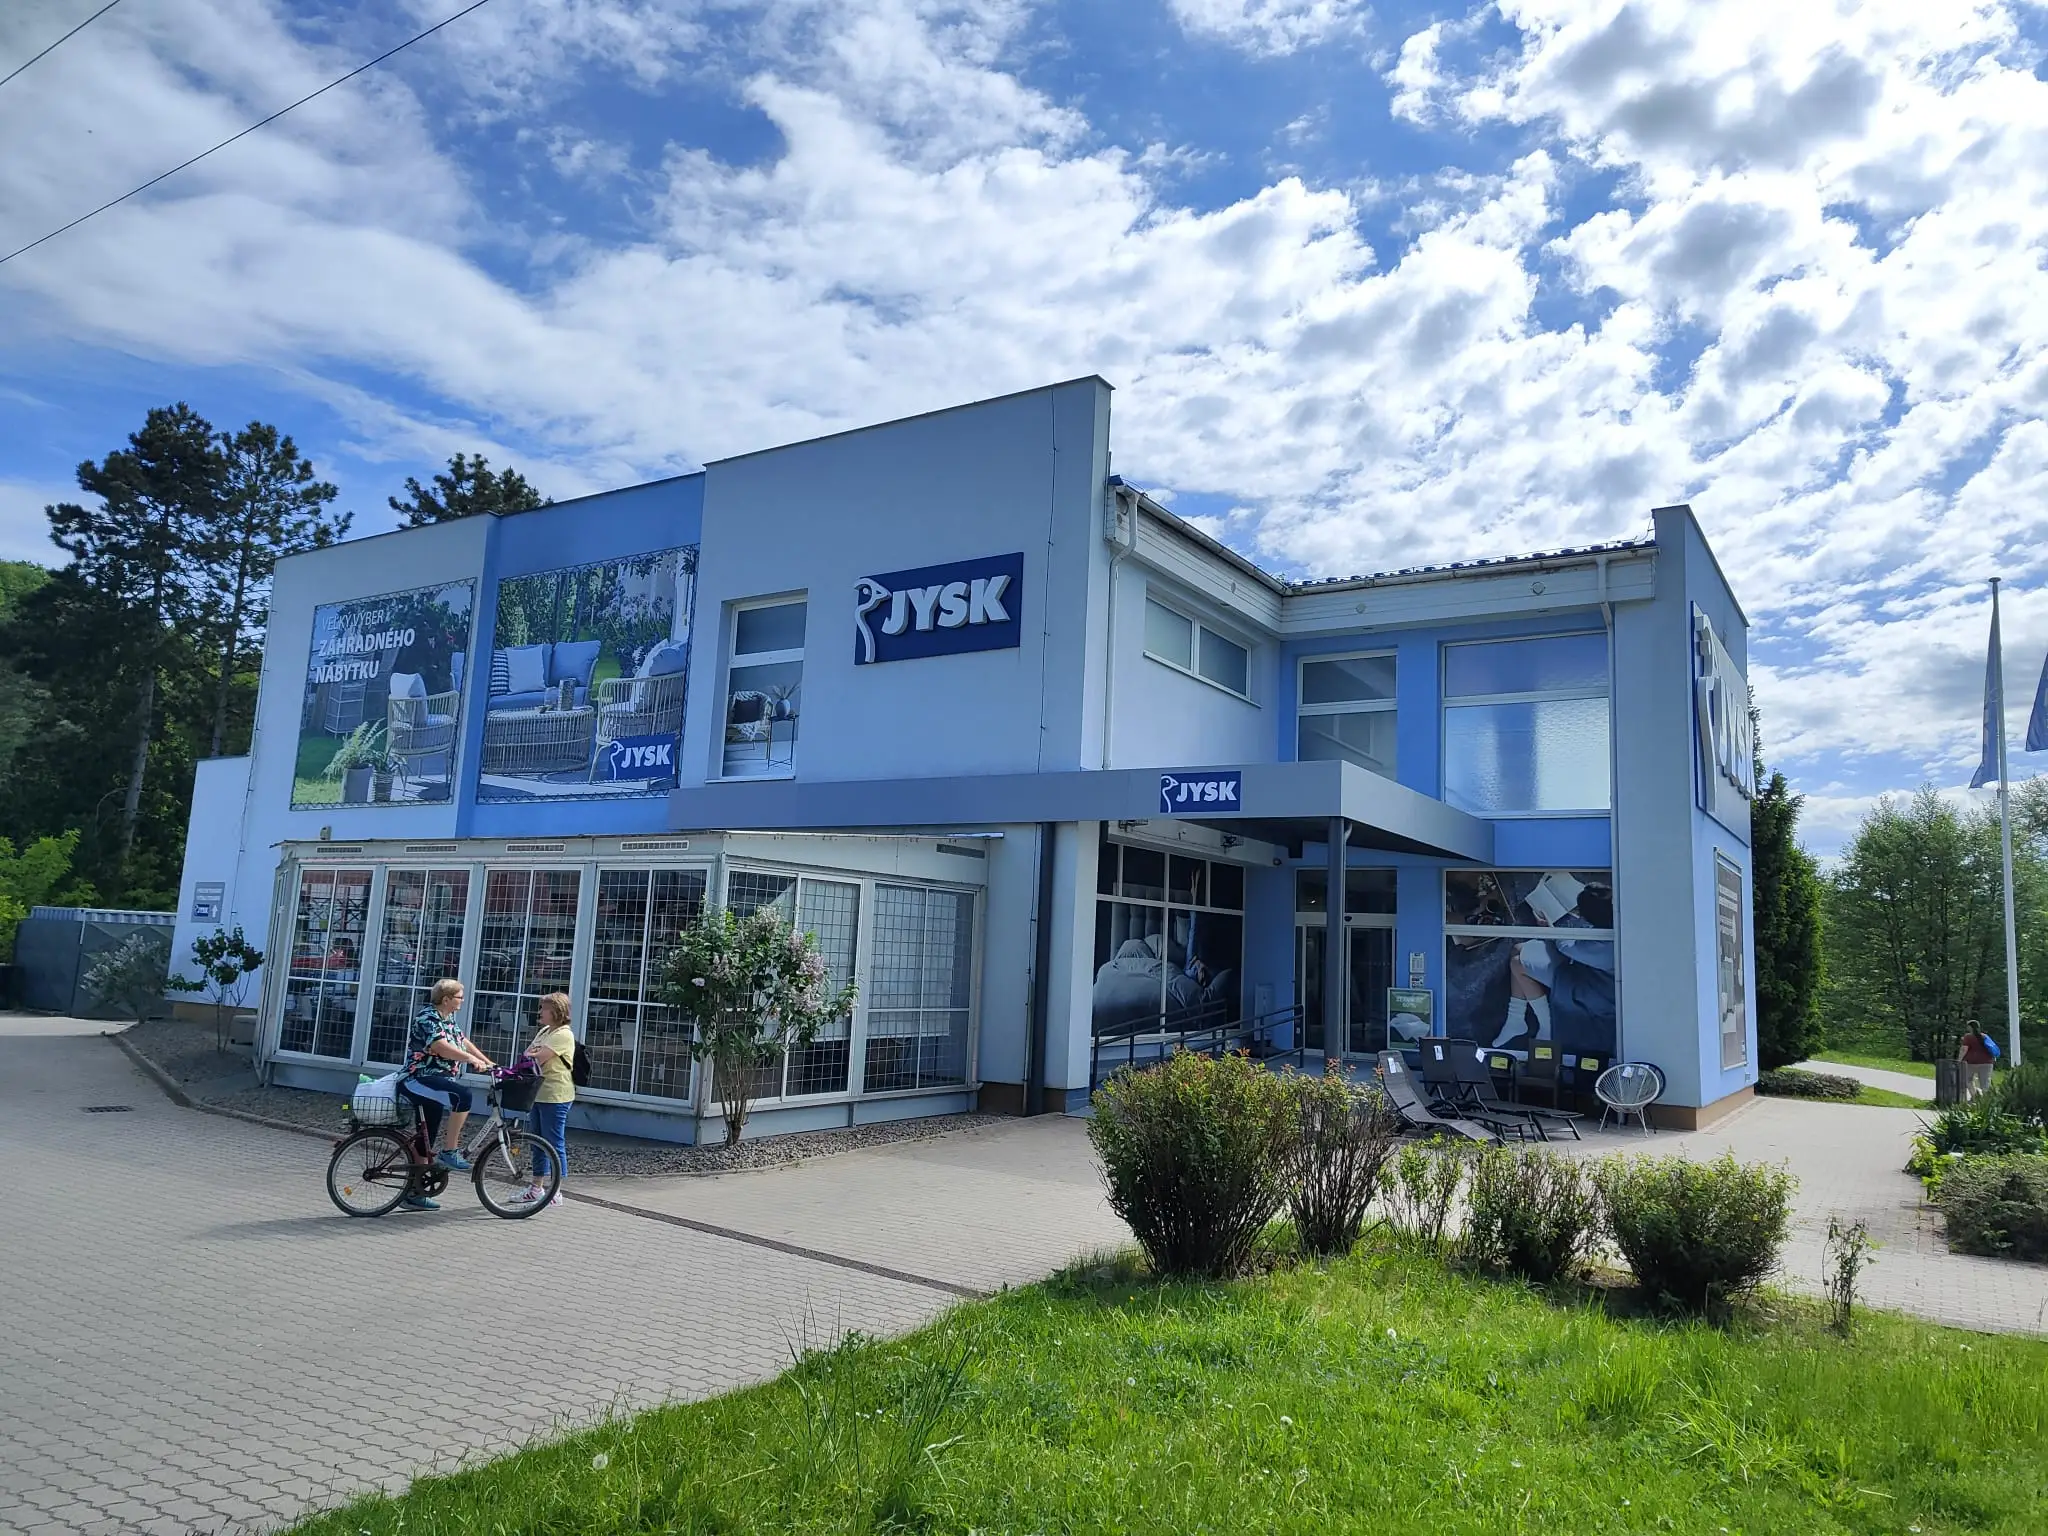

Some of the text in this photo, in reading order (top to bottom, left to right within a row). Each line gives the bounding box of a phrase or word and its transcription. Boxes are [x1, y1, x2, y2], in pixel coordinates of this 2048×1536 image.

[881, 574, 1011, 635] JYSK
[353, 609, 384, 627] VÝBER
[318, 627, 416, 657] ZÁHRADNÉHO
[315, 660, 380, 684] NÁBYTKU
[620, 743, 672, 768] JYSK
[1175, 781, 1238, 803] JYSK
